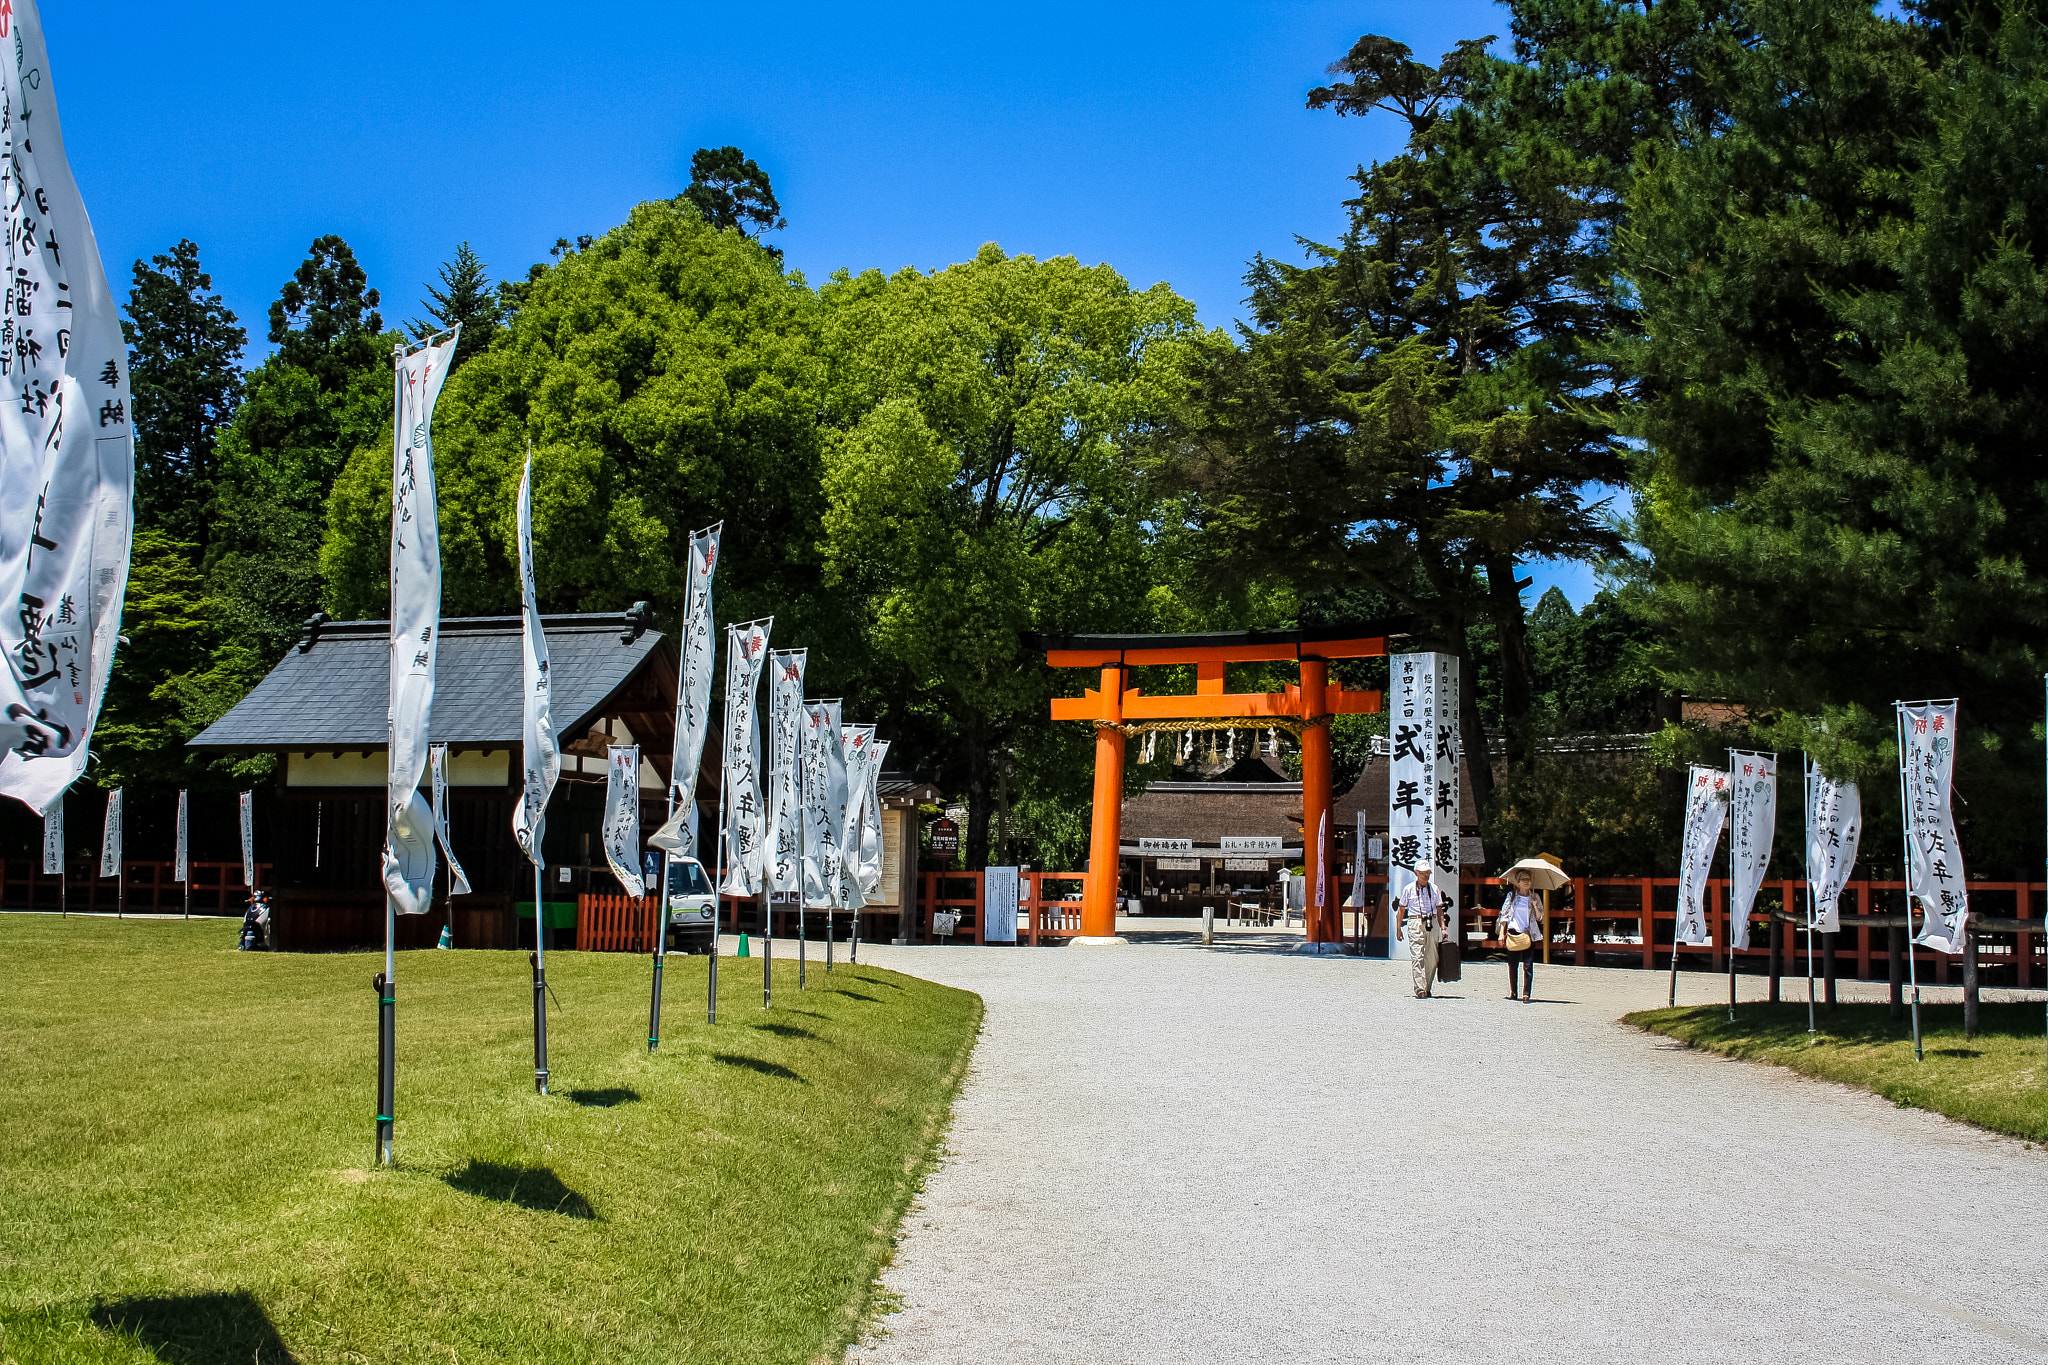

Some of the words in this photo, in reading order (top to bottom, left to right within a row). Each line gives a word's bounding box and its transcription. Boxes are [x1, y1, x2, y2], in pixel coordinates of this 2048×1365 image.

[1402, 661, 1415, 718] 第四十二回
[1441, 661, 1450, 718] 第四十二回
[1423, 673, 1434, 796] 悠久の歴史伝える御遷宮
[1423, 805, 1434, 876] 平成二十七年
